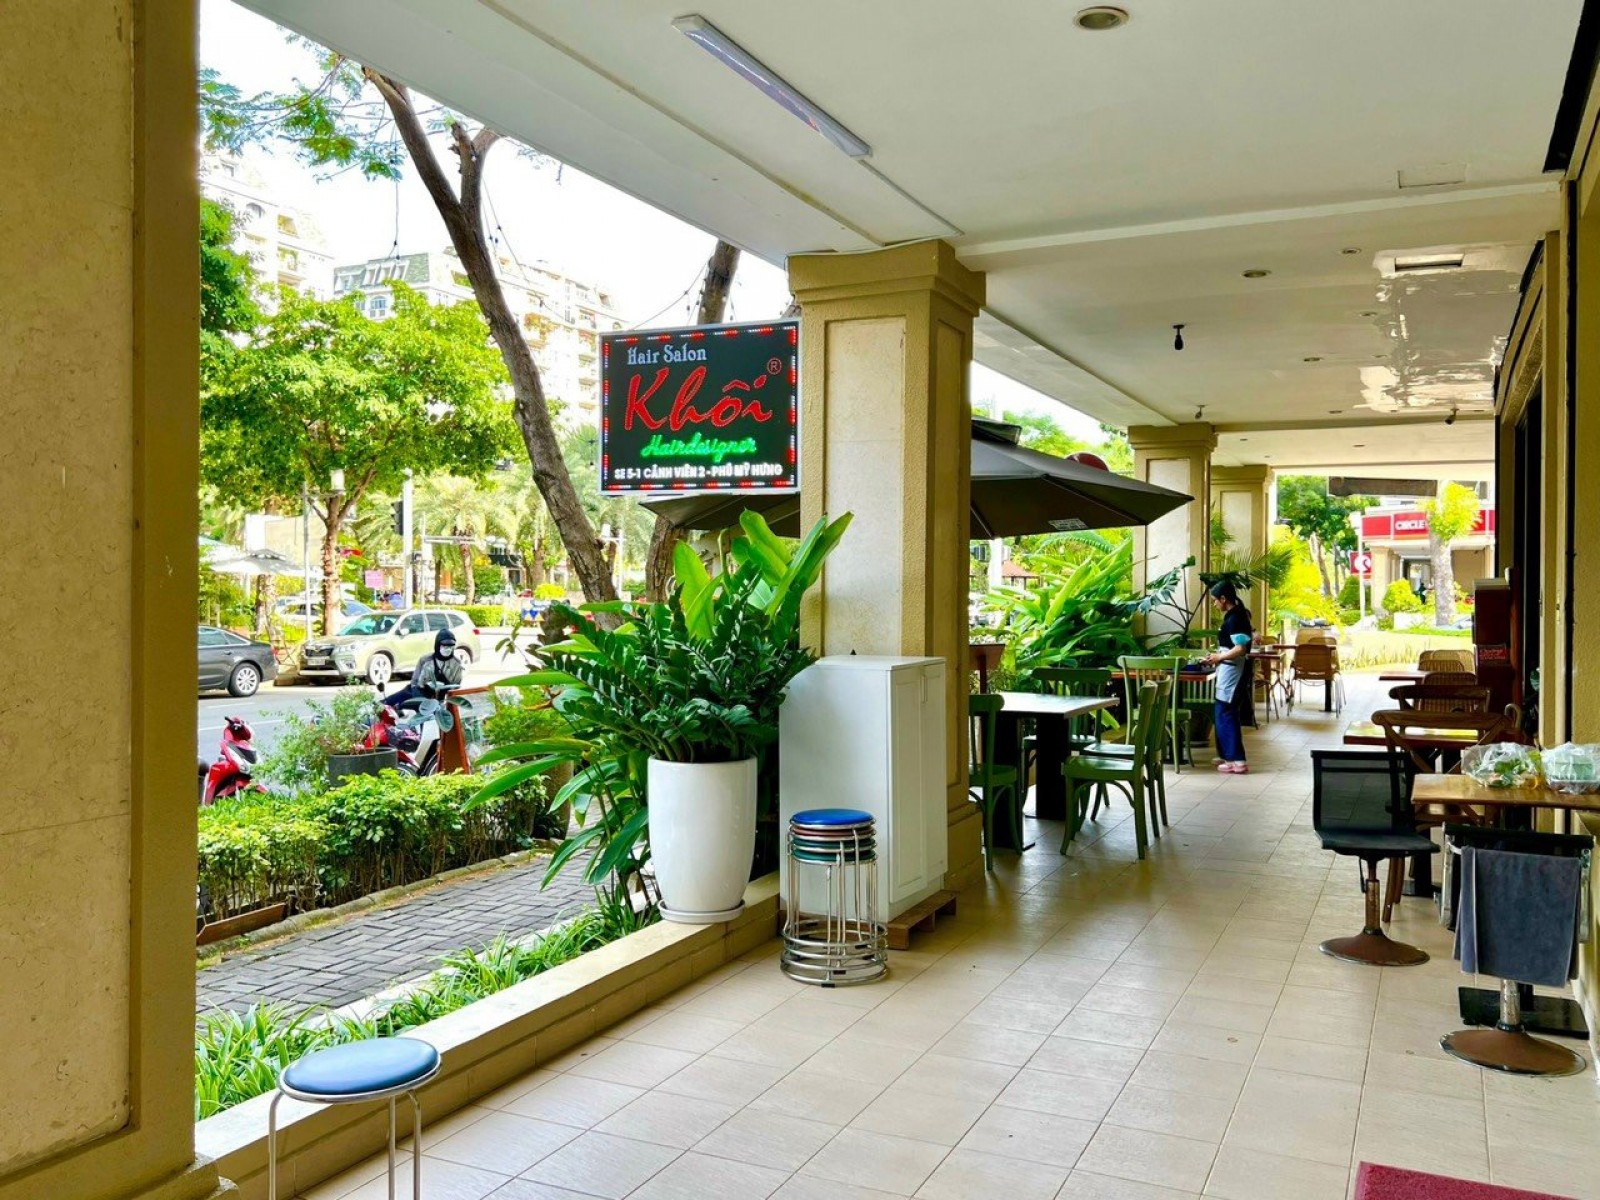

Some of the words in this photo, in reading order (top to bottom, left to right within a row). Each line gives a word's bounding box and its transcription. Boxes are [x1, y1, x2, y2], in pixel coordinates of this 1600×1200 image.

[627, 347, 660, 365] Hair
[663, 343, 707, 363] Salon
[698, 465, 706, 478] 2
